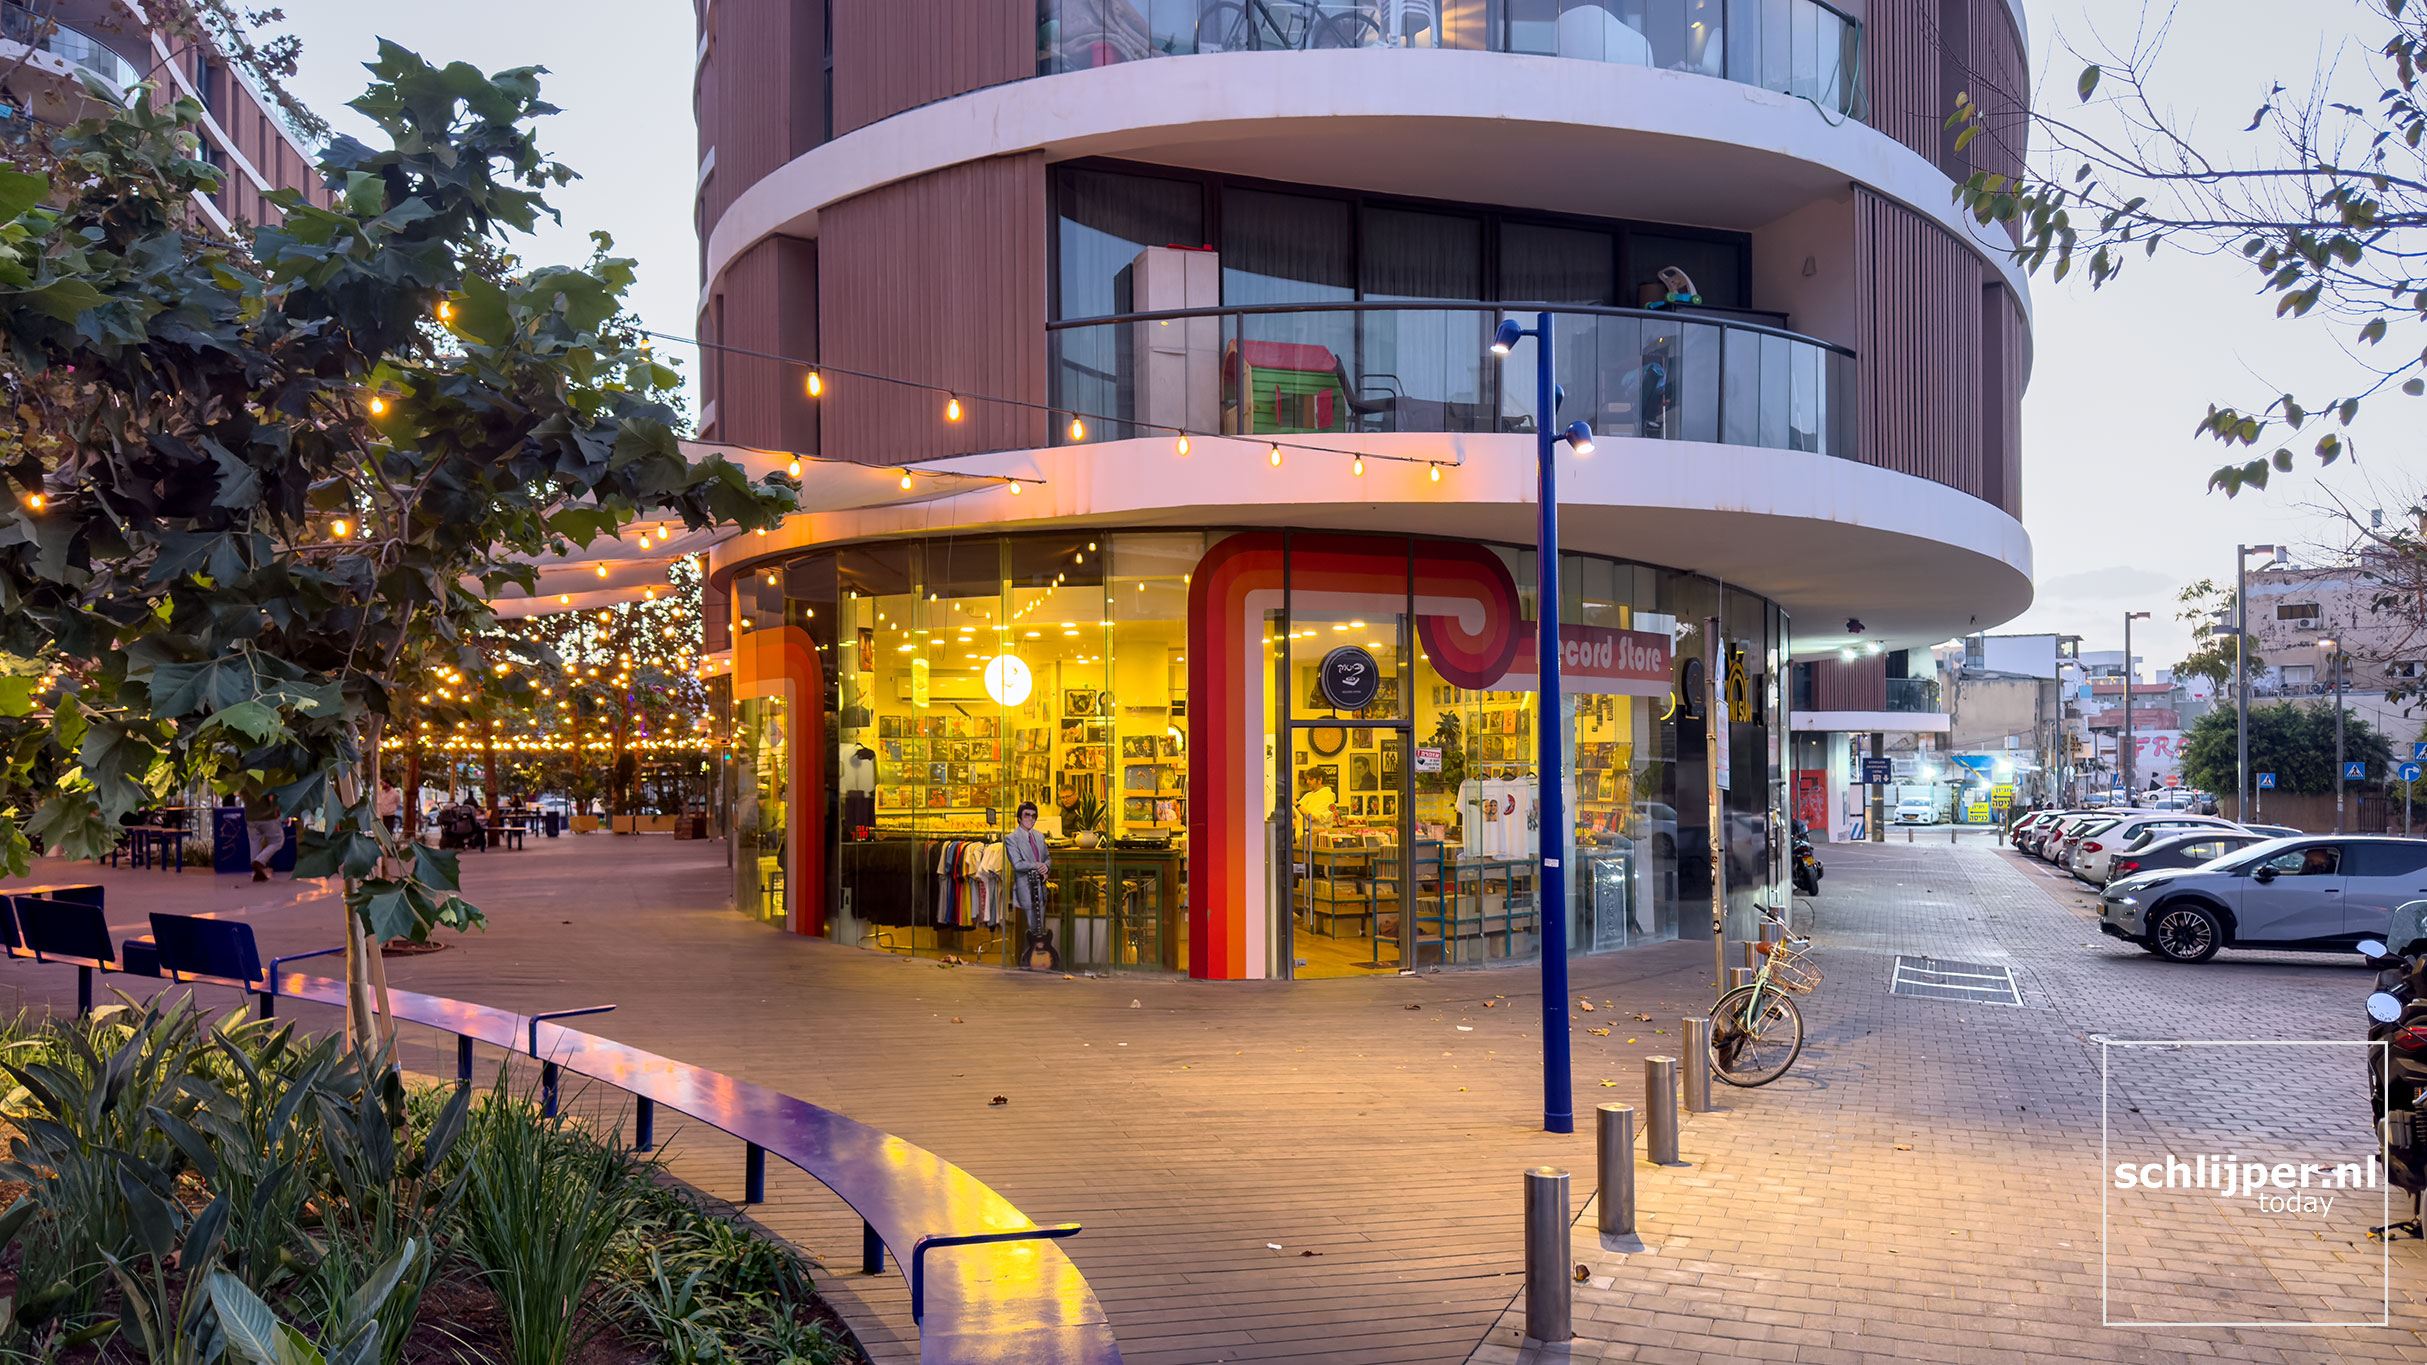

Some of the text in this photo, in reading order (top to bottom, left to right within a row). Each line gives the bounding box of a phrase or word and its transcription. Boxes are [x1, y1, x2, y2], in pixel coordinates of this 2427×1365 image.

[1536, 630, 1662, 673] cord Store
[1992, 799, 2012, 808] ניסה
[1968, 814, 1989, 822] כניסה
